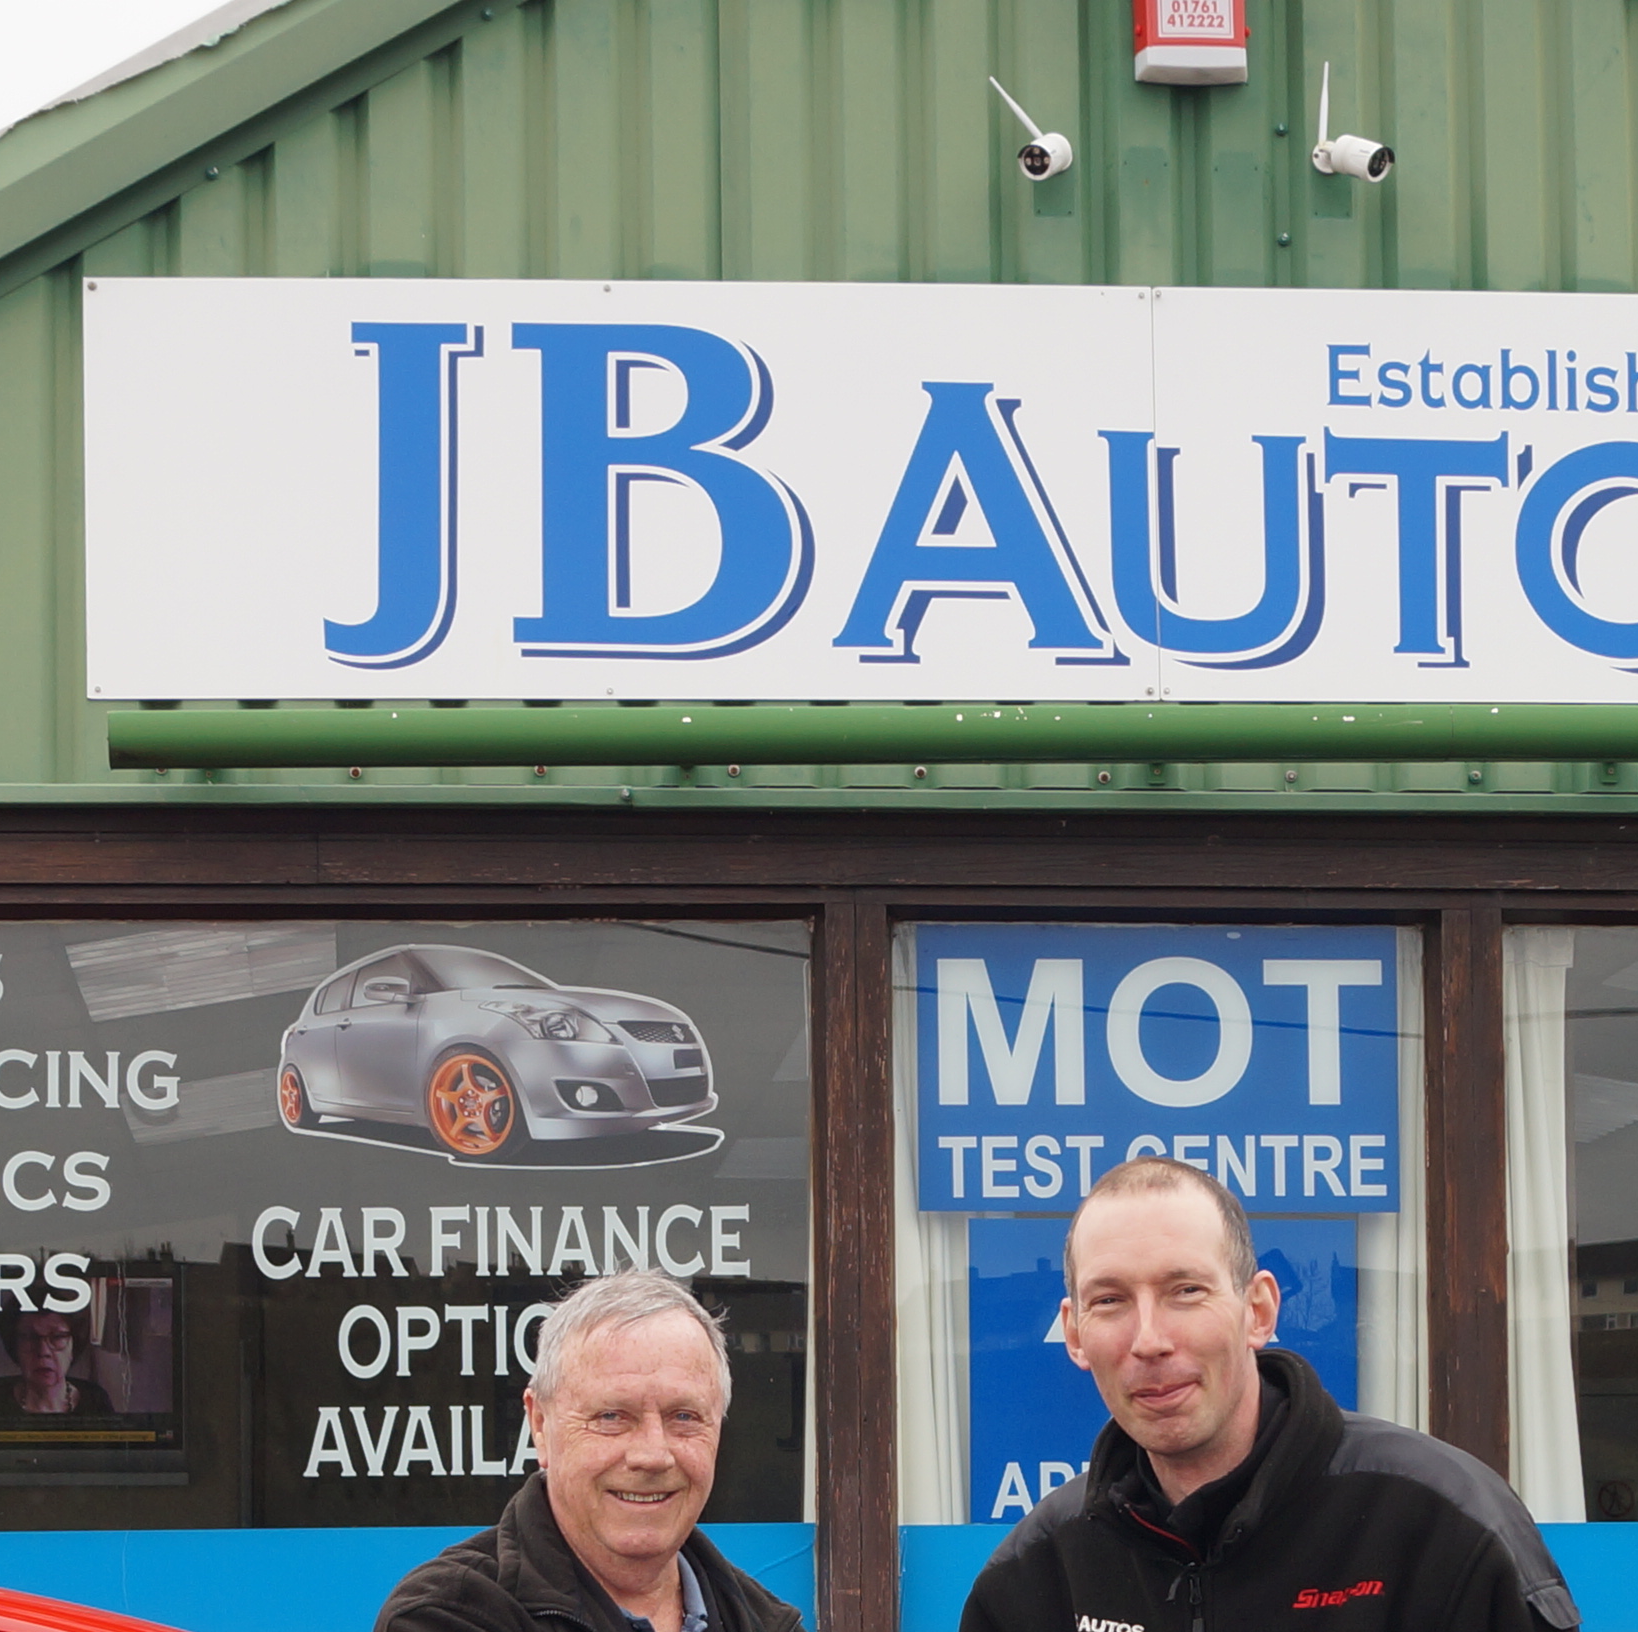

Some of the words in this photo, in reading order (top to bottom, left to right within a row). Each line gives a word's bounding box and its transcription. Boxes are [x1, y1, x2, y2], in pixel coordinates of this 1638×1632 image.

[1167, 14, 1225, 28] 412222
[1171, 0, 1218, 13] 01761
[321, 320, 815, 669] JB
[936, 956, 1383, 1108] MOT
[938, 1135, 1104, 1198] TEST
[252, 1205, 408, 1280] CAR
[429, 1203, 751, 1279] FINANCE
[338, 1303, 556, 1379] OPTIO
